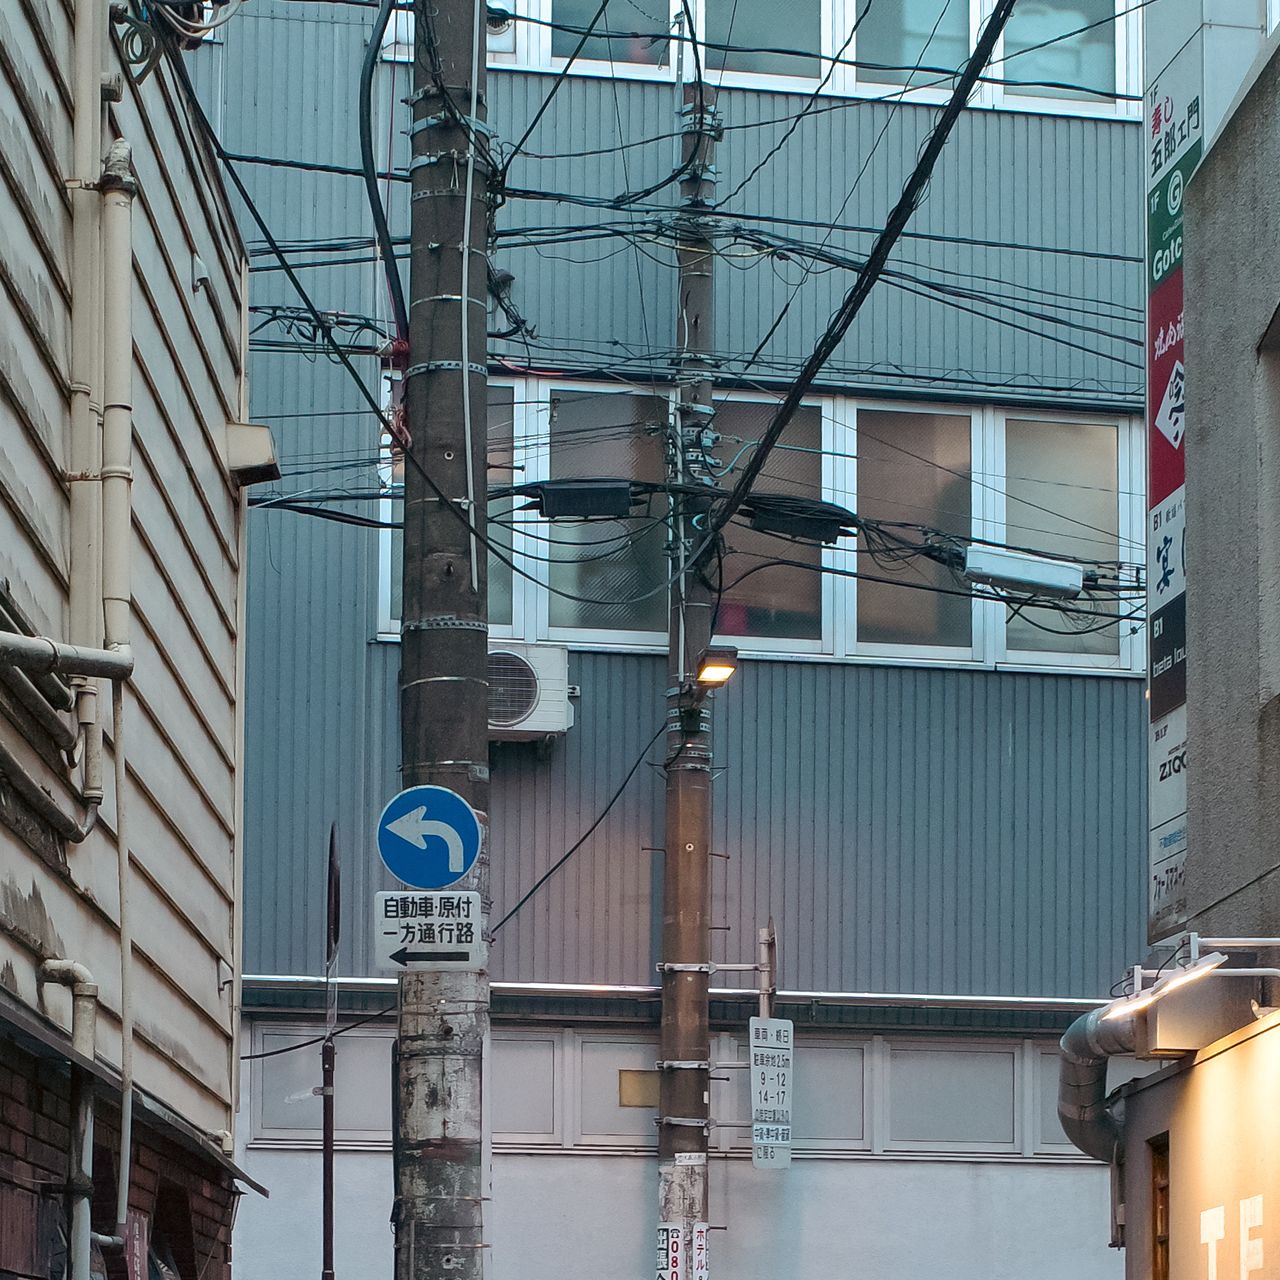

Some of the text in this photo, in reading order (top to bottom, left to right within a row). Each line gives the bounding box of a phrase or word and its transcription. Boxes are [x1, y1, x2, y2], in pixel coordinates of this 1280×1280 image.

[1150, 84, 1159, 108] 1F
[1151, 190, 1160, 214] 1F
[1154, 510, 1163, 532] B1
[1154, 616, 1164, 639] B1
[1153, 655, 1172, 678] beta
[384, 896, 472, 919] 自動車・原付
[383, 922, 474, 944] 一方通行路
